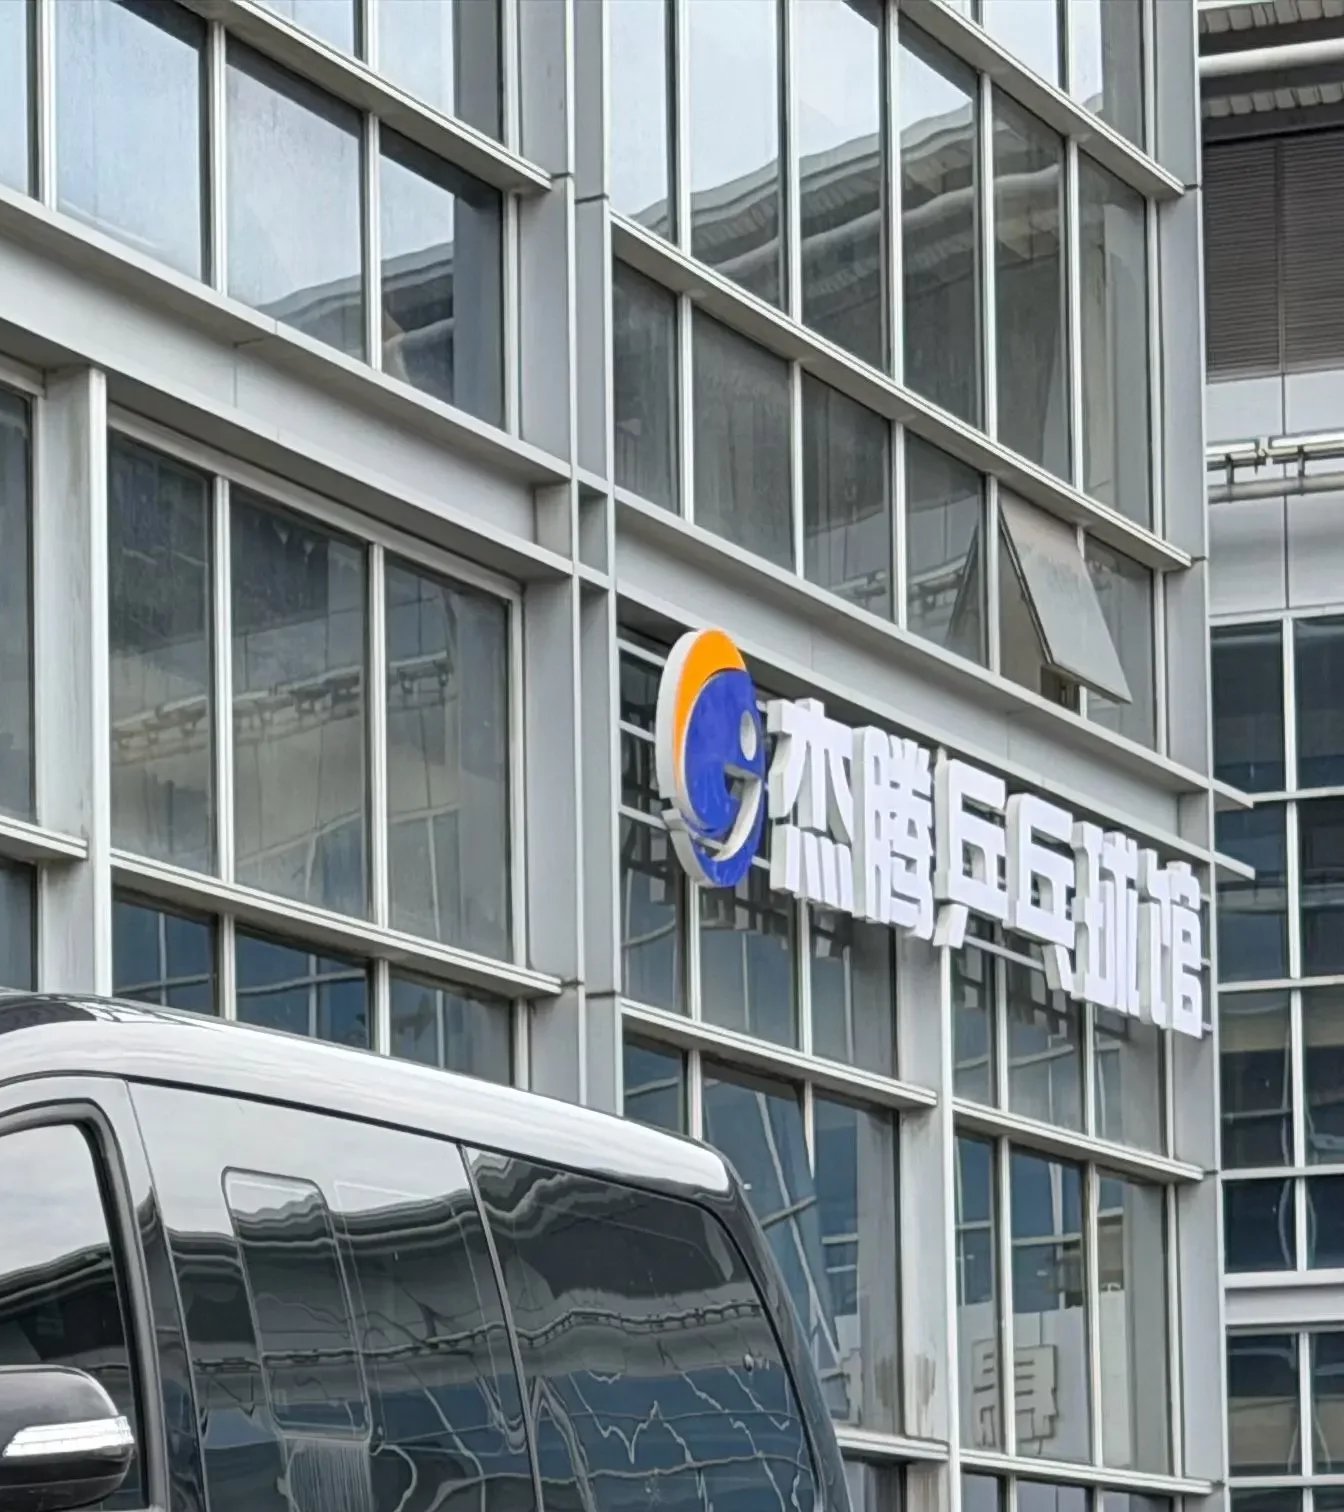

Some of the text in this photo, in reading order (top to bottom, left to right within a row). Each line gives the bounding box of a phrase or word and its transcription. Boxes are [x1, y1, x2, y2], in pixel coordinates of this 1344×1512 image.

[768, 698, 1202, 1039] 杰腾乒乓球馆
